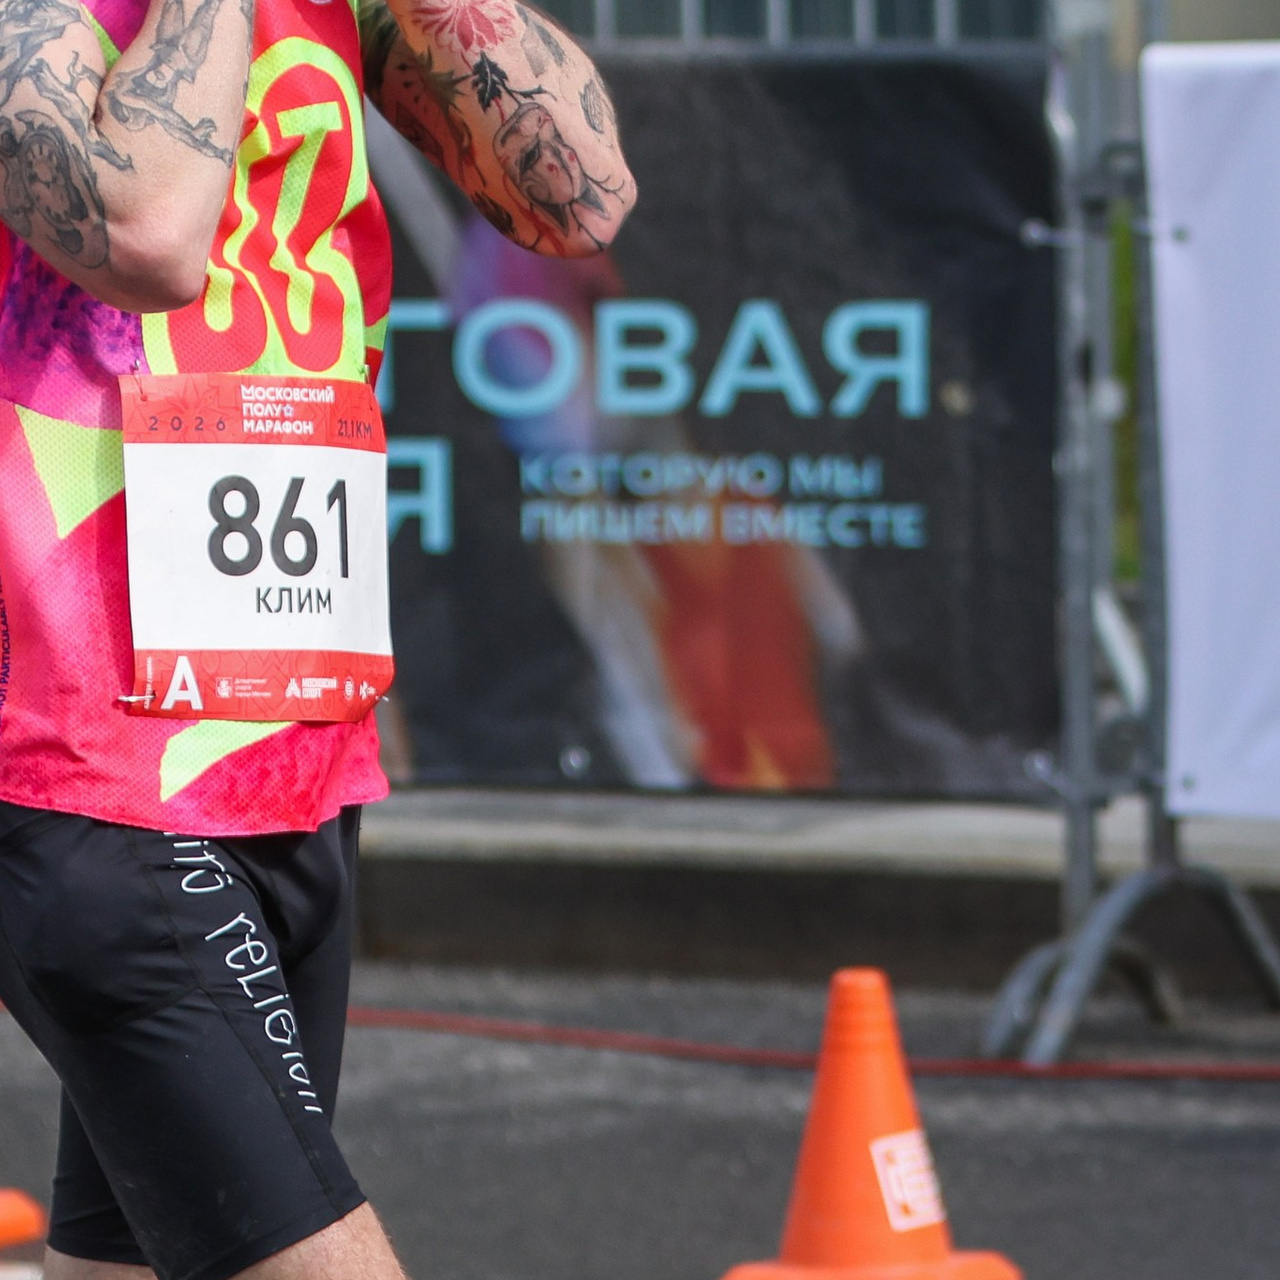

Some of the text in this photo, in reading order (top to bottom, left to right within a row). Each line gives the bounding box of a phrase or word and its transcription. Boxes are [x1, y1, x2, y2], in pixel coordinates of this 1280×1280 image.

[241, 384, 335, 403] МОСКОВСКИЙ
[148, 416, 226, 432] 2026
[242, 402, 284, 418] ПОЛУ
[242, 419, 314, 436] МАРАФОН
[520, 451, 883, 499] КОТОРУЮ МЫ
[207, 474, 350, 580] 861
[520, 500, 928, 548] ПИШЕМ ВМЕСТЕ
[255, 586, 333, 615] КЛИМ
[160, 655, 204, 711] A
